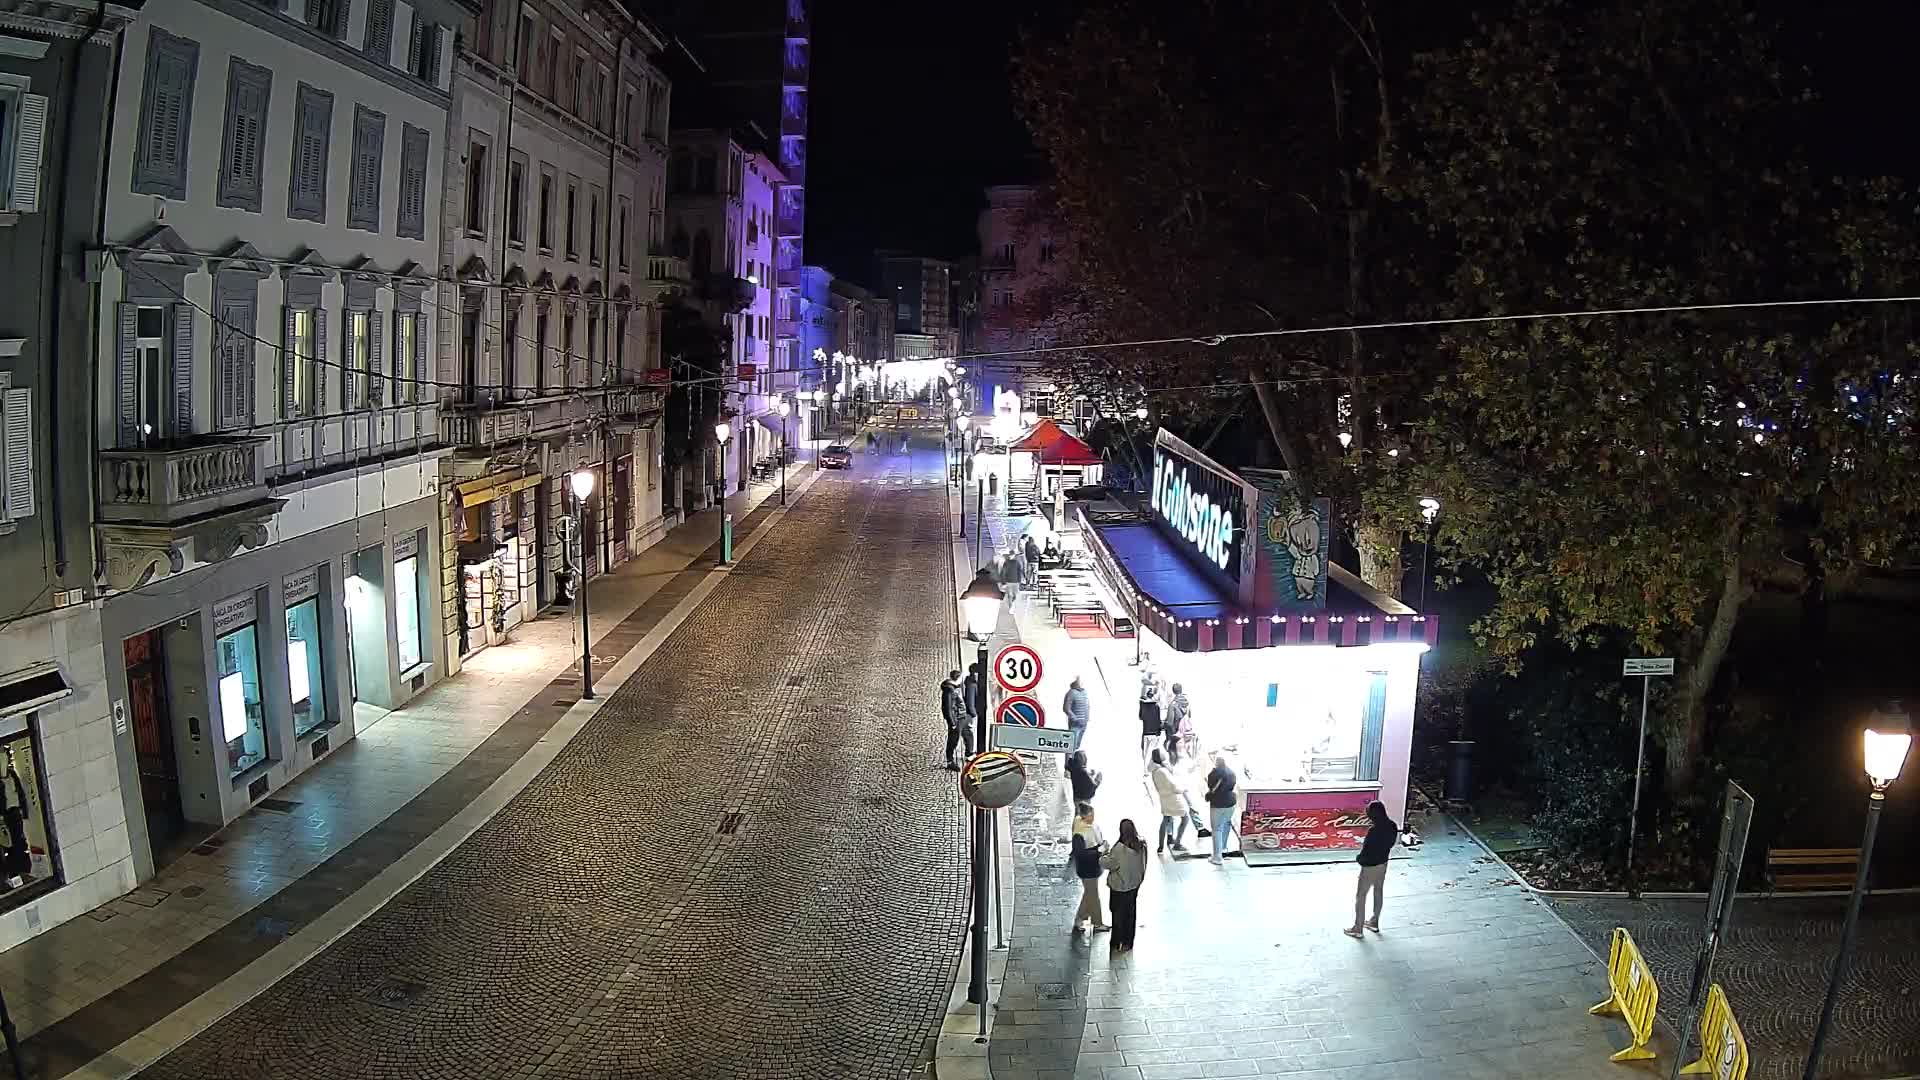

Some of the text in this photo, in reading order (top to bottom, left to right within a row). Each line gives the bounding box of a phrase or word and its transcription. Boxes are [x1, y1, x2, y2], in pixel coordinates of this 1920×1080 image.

[1161, 458, 1232, 570] Golosone
[1006, 657, 1033, 680] 30
[1038, 737, 1069, 748] Dante
